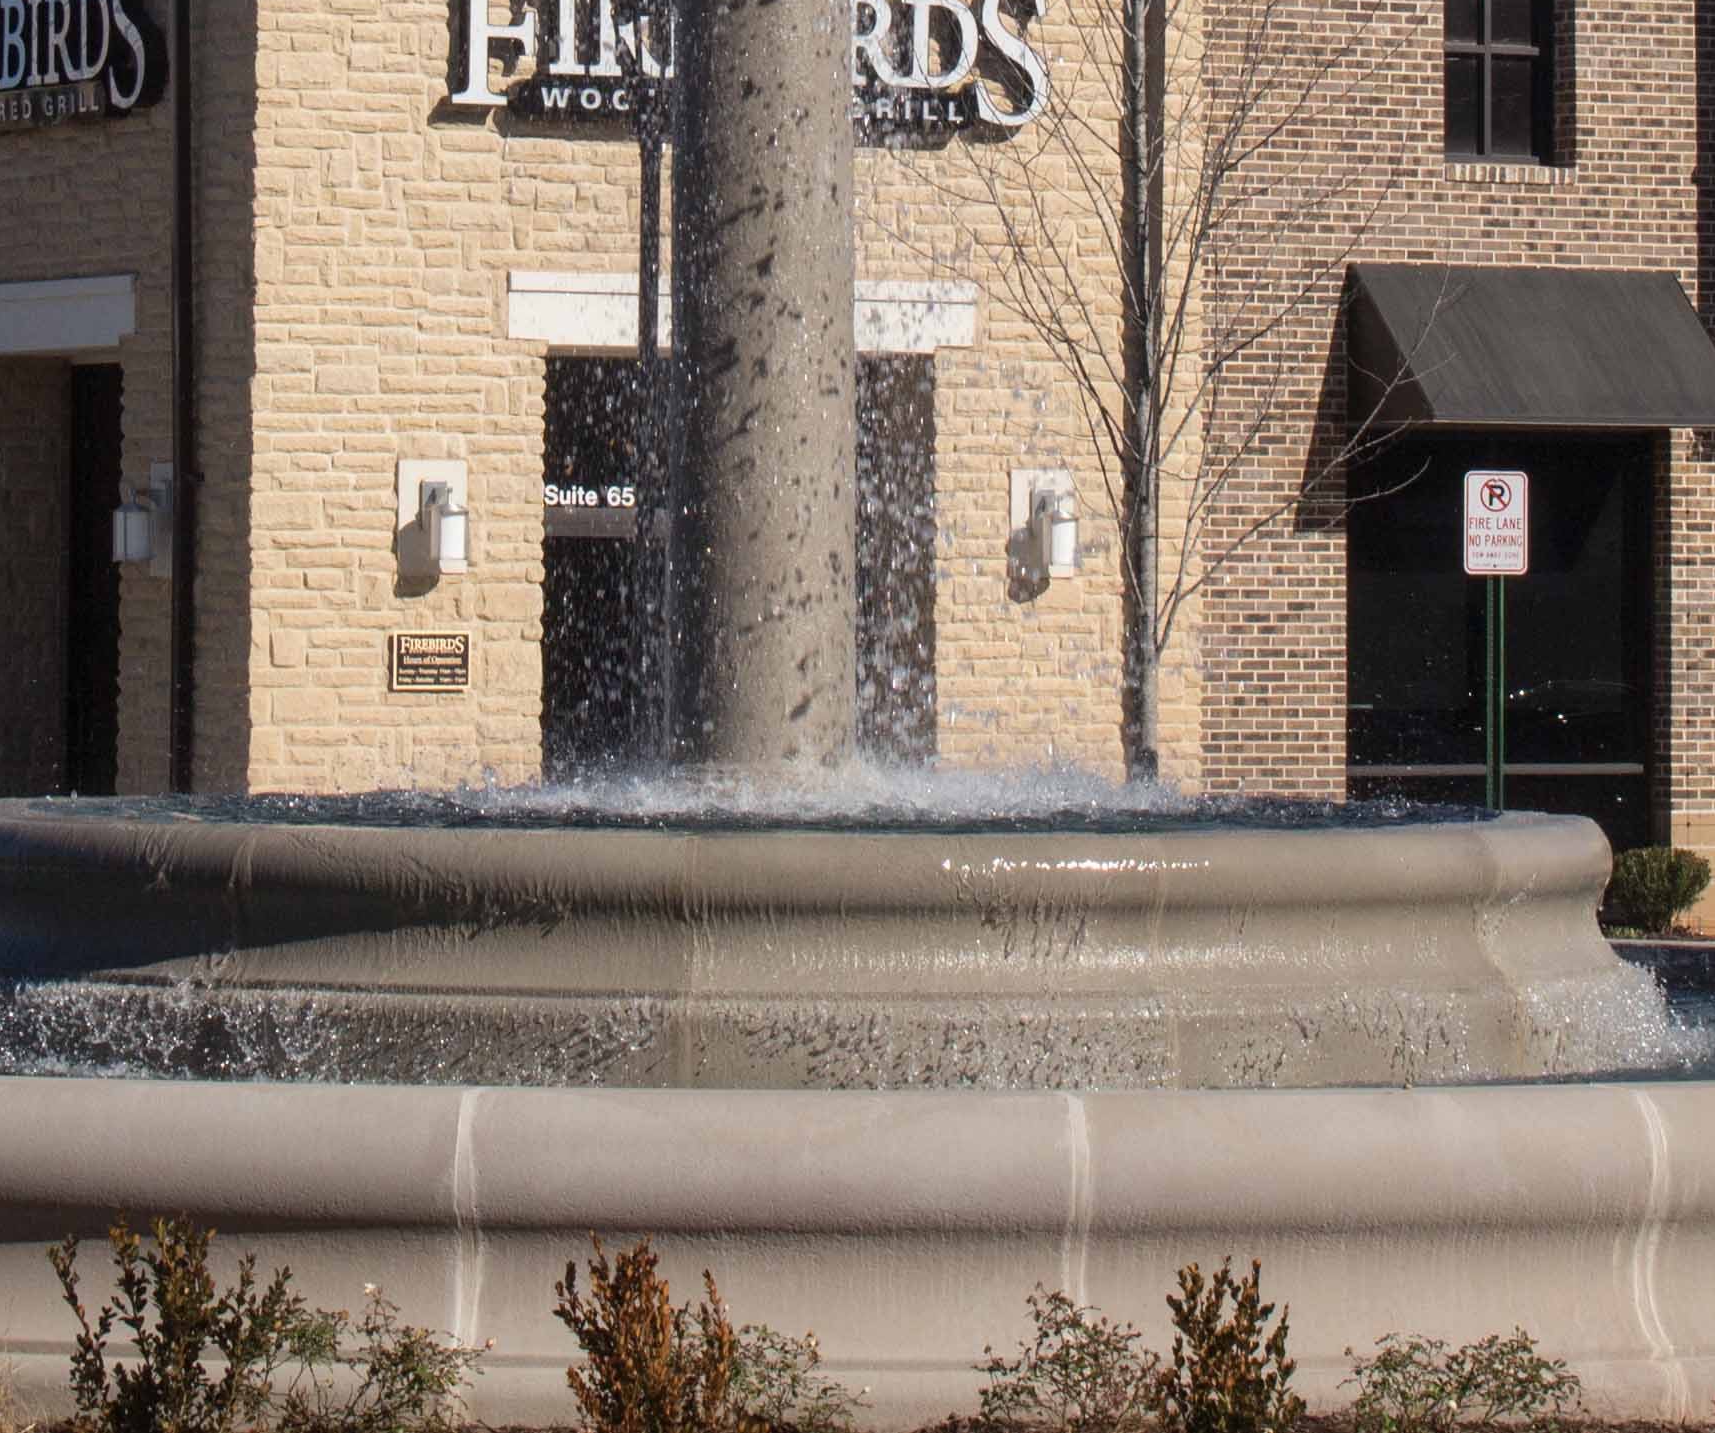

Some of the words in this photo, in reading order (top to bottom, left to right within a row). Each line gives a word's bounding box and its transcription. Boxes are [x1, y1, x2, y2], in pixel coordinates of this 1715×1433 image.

[44, 92, 100, 117] GRILL
[540, 86, 655, 111] WOO
[544, 484, 598, 506] Suite
[607, 486, 636, 506] 65
[1469, 517, 1491, 529] FIRE
[1496, 517, 1522, 529] LANE
[1469, 534, 1481, 546] NO
[1485, 534, 1522, 547] PARKING
[400, 636, 465, 654] FIREBIRDS
